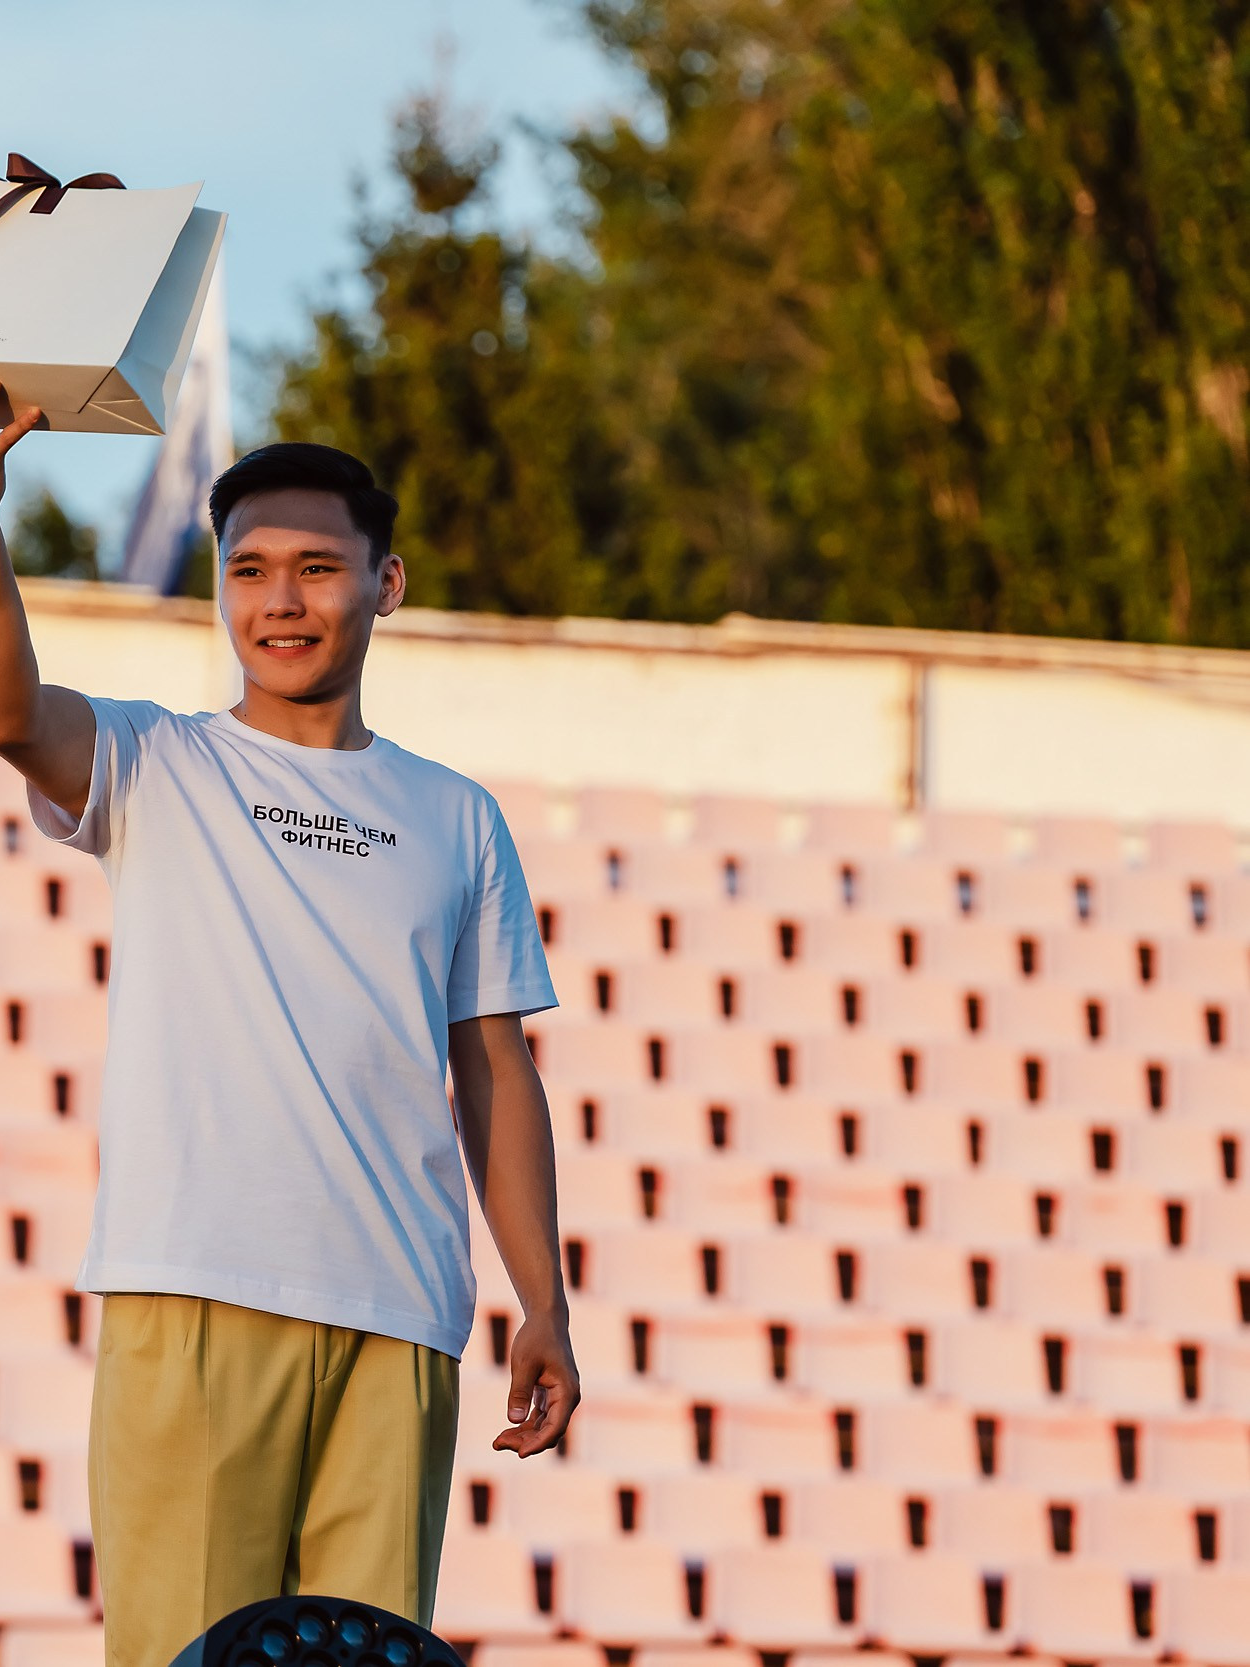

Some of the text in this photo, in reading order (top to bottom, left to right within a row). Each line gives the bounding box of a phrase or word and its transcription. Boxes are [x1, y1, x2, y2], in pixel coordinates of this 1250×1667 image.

[253, 804, 397, 847] БОЛЬШЕ ЧЕМ
[281, 829, 371, 858] ФИТНЕС
